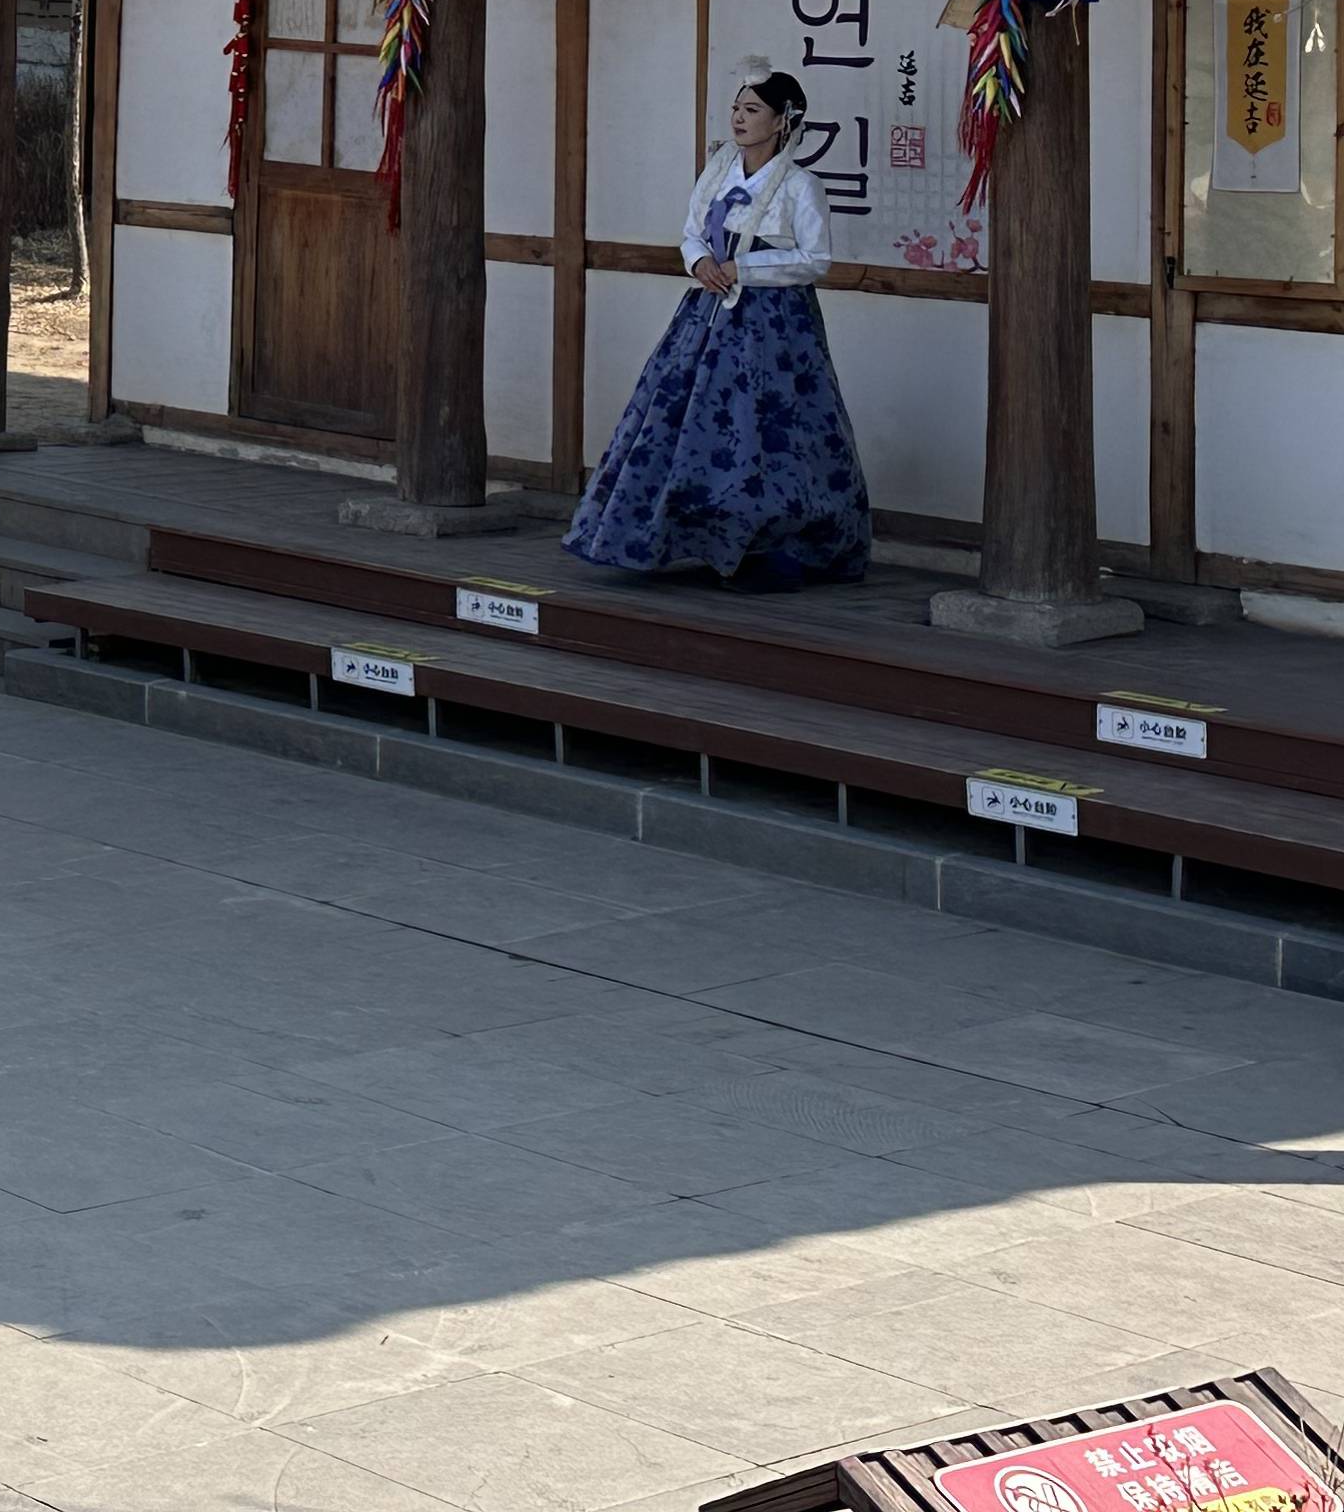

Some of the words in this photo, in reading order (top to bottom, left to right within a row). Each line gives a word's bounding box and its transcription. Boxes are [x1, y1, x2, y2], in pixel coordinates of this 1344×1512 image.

[1243, 6, 1270, 135] 我在延吉
[1083, 1425, 1217, 1479] 禁止吸烟
